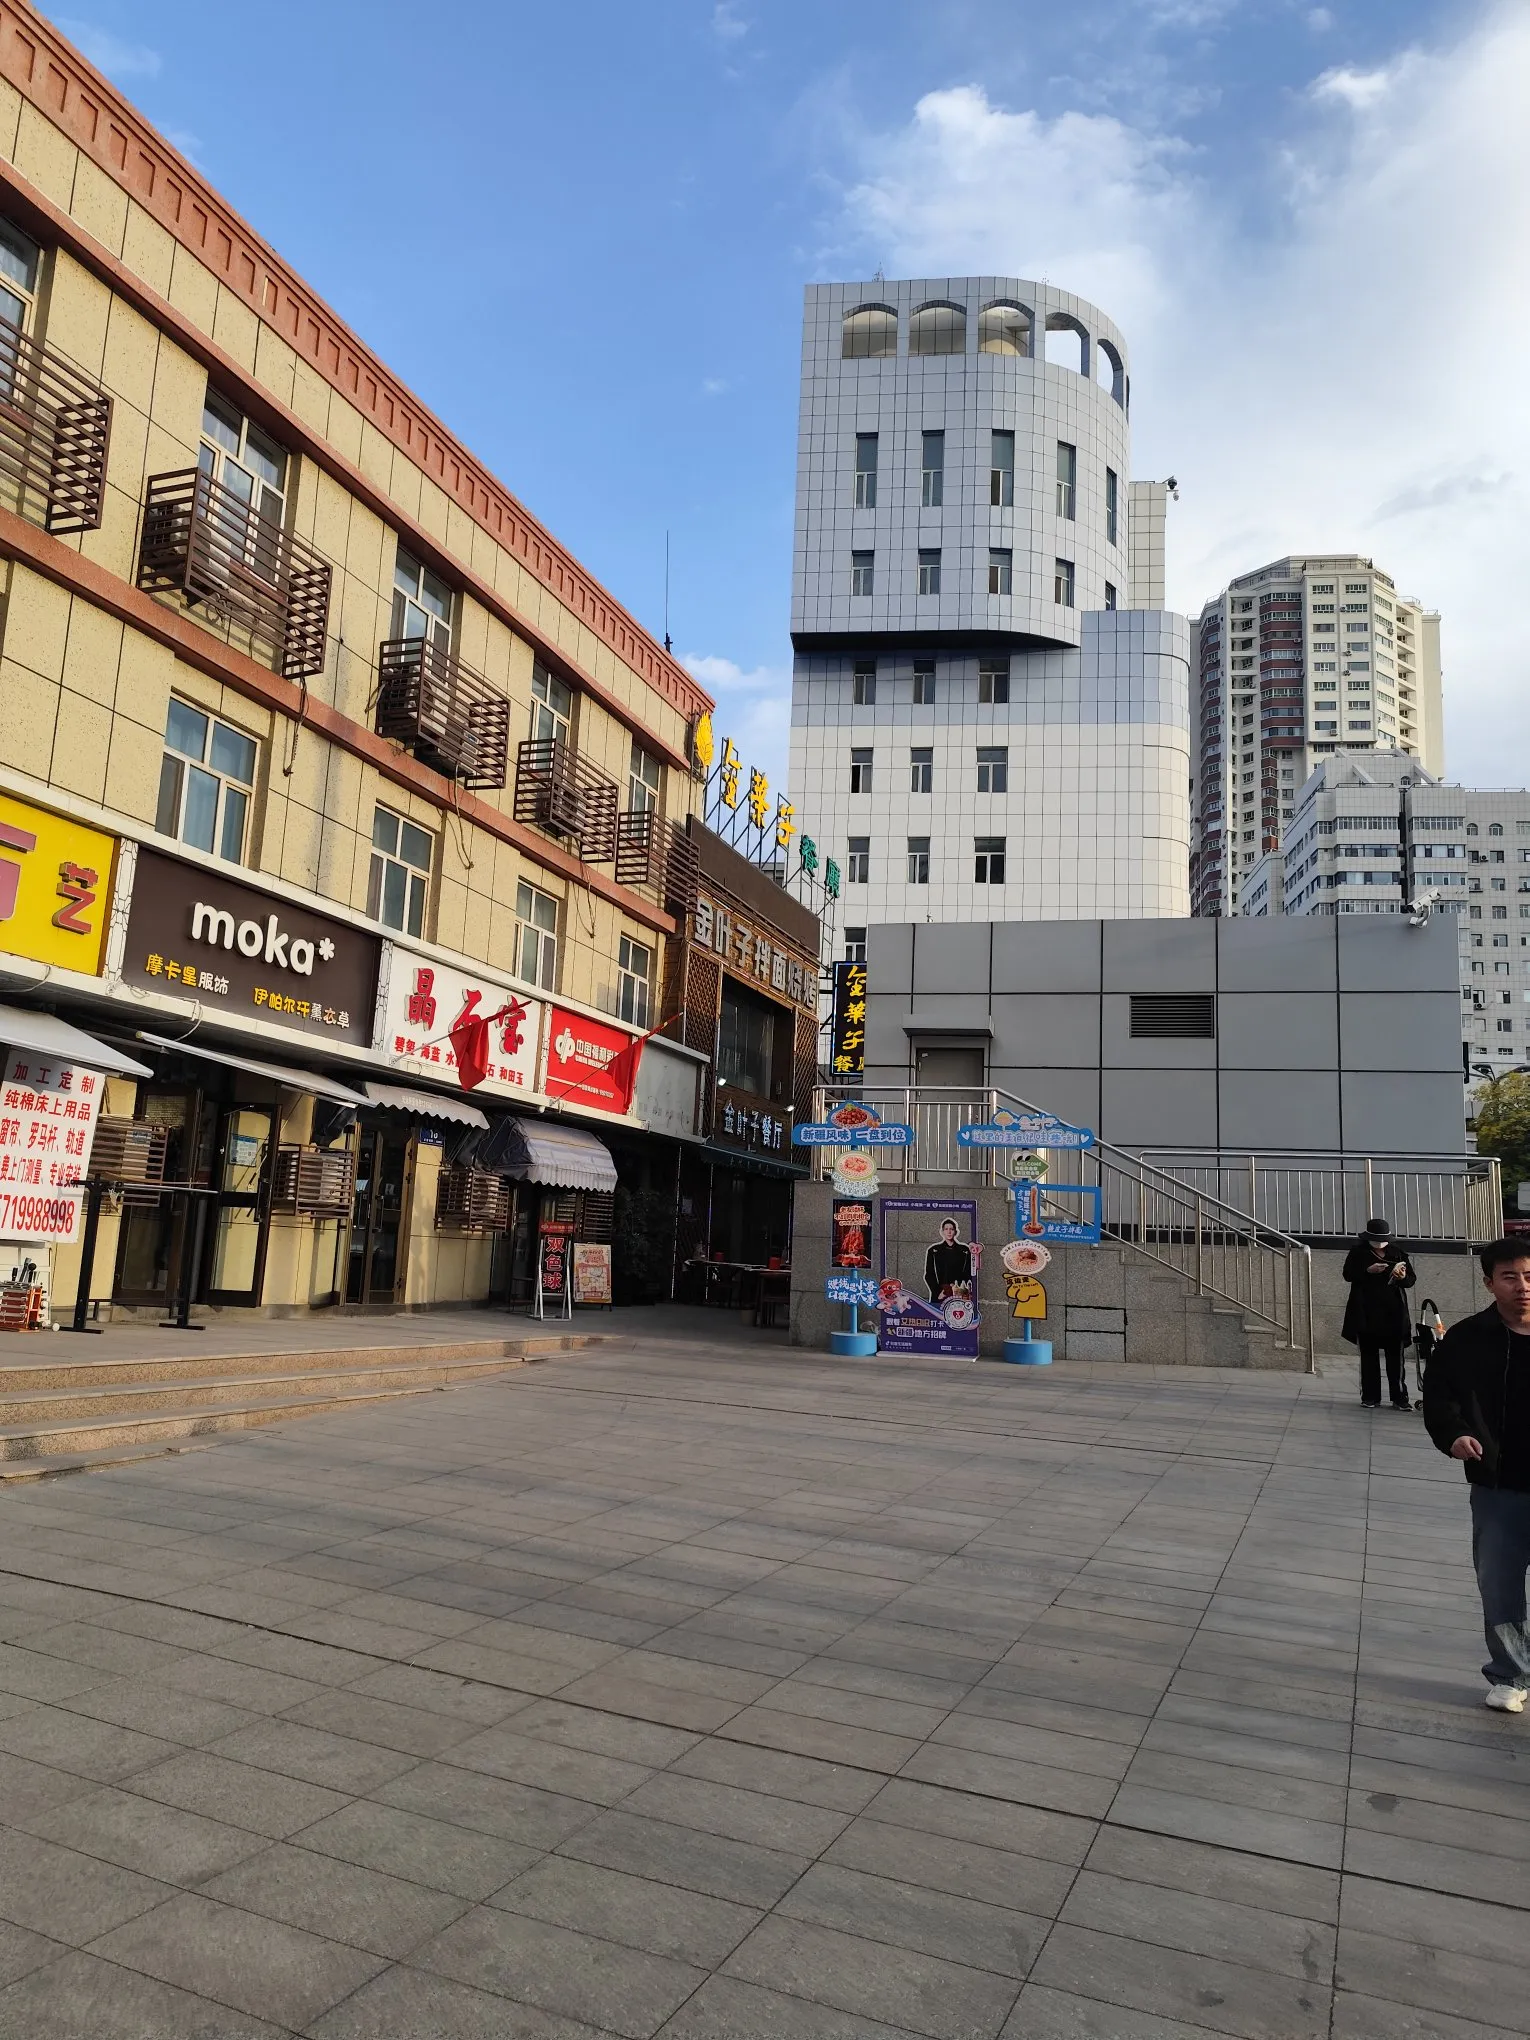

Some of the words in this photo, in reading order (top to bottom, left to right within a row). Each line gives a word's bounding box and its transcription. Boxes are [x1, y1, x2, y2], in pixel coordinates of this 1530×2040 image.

[13, 1060, 96, 1094] 加工定制
[499, 1066, 524, 1086] 和田玉
[4, 1089, 91, 1121] 纯棉床上用品
[801, 1127, 851, 1142] 新疆风味
[0, 1194, 75, 1233] 719988998
[543, 1237, 565, 1290] 双色球
